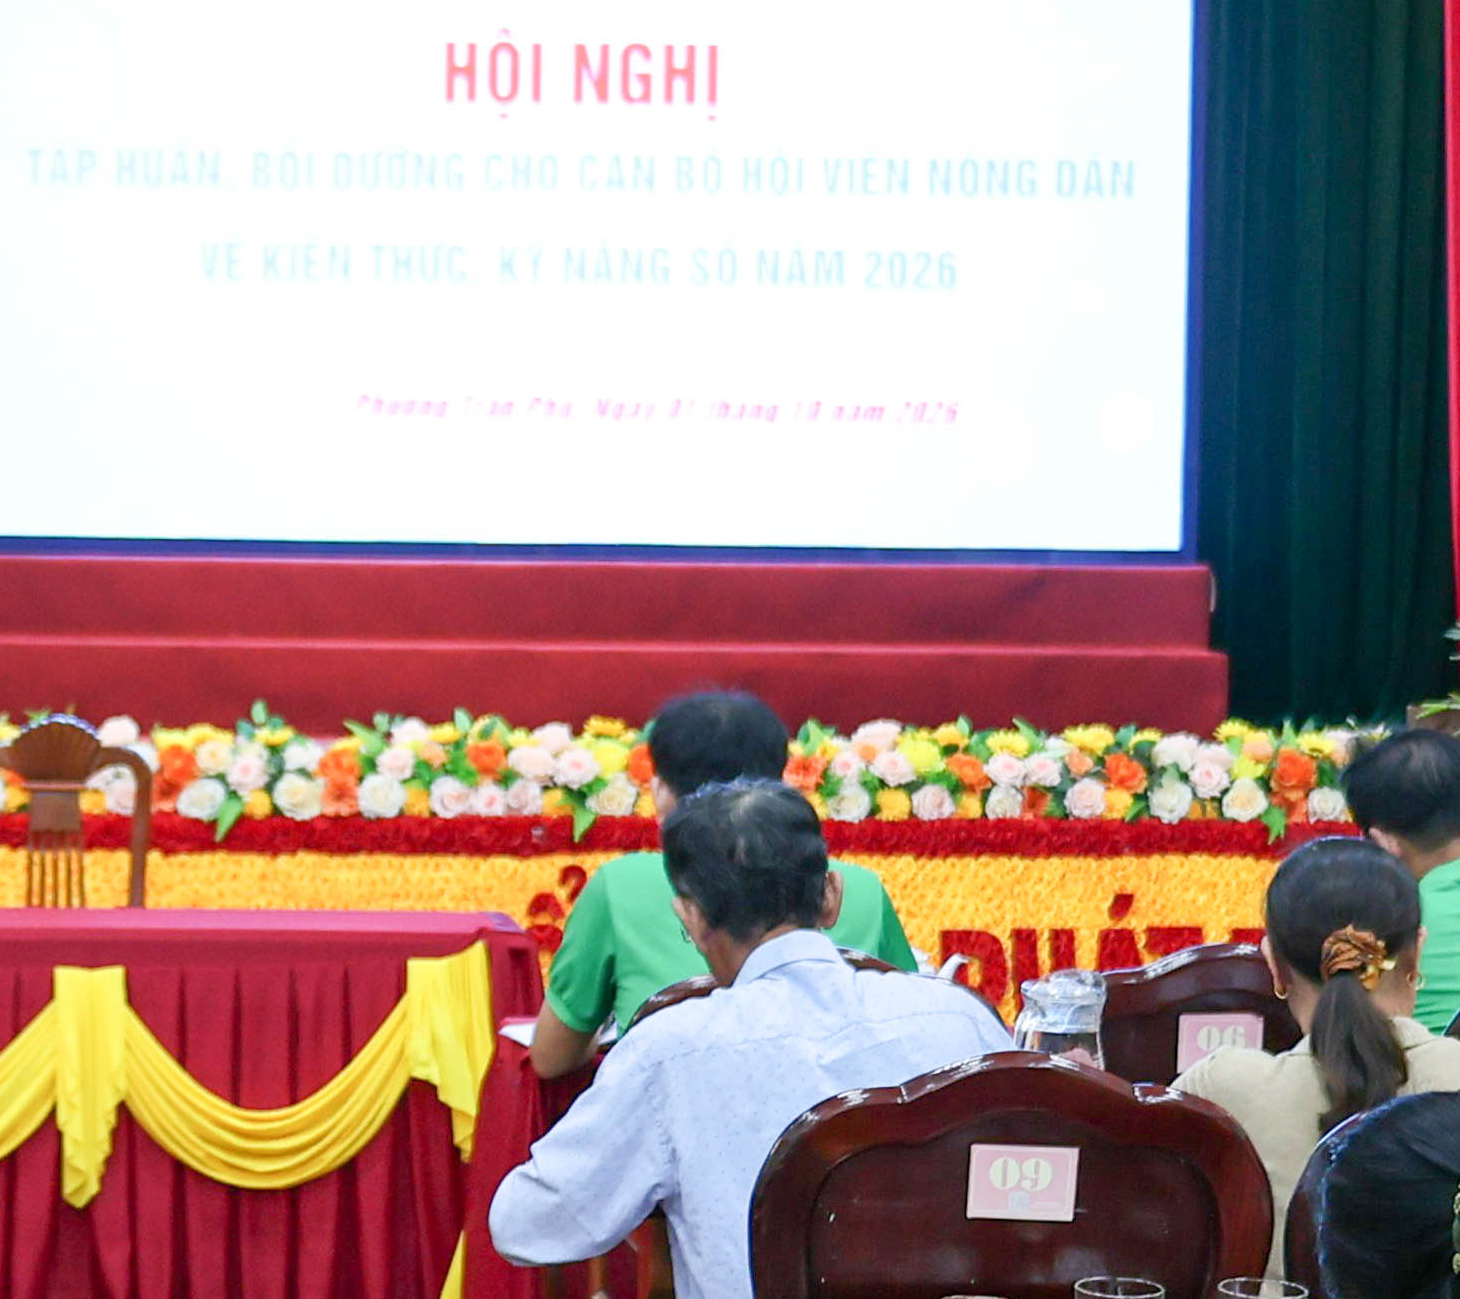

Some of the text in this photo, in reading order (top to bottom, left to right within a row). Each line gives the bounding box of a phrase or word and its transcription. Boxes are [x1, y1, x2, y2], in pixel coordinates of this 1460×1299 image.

[444, 27, 720, 122] HỘI NGHỊ
[862, 250, 959, 291] 2026
[989, 1157, 1053, 1191] 09
